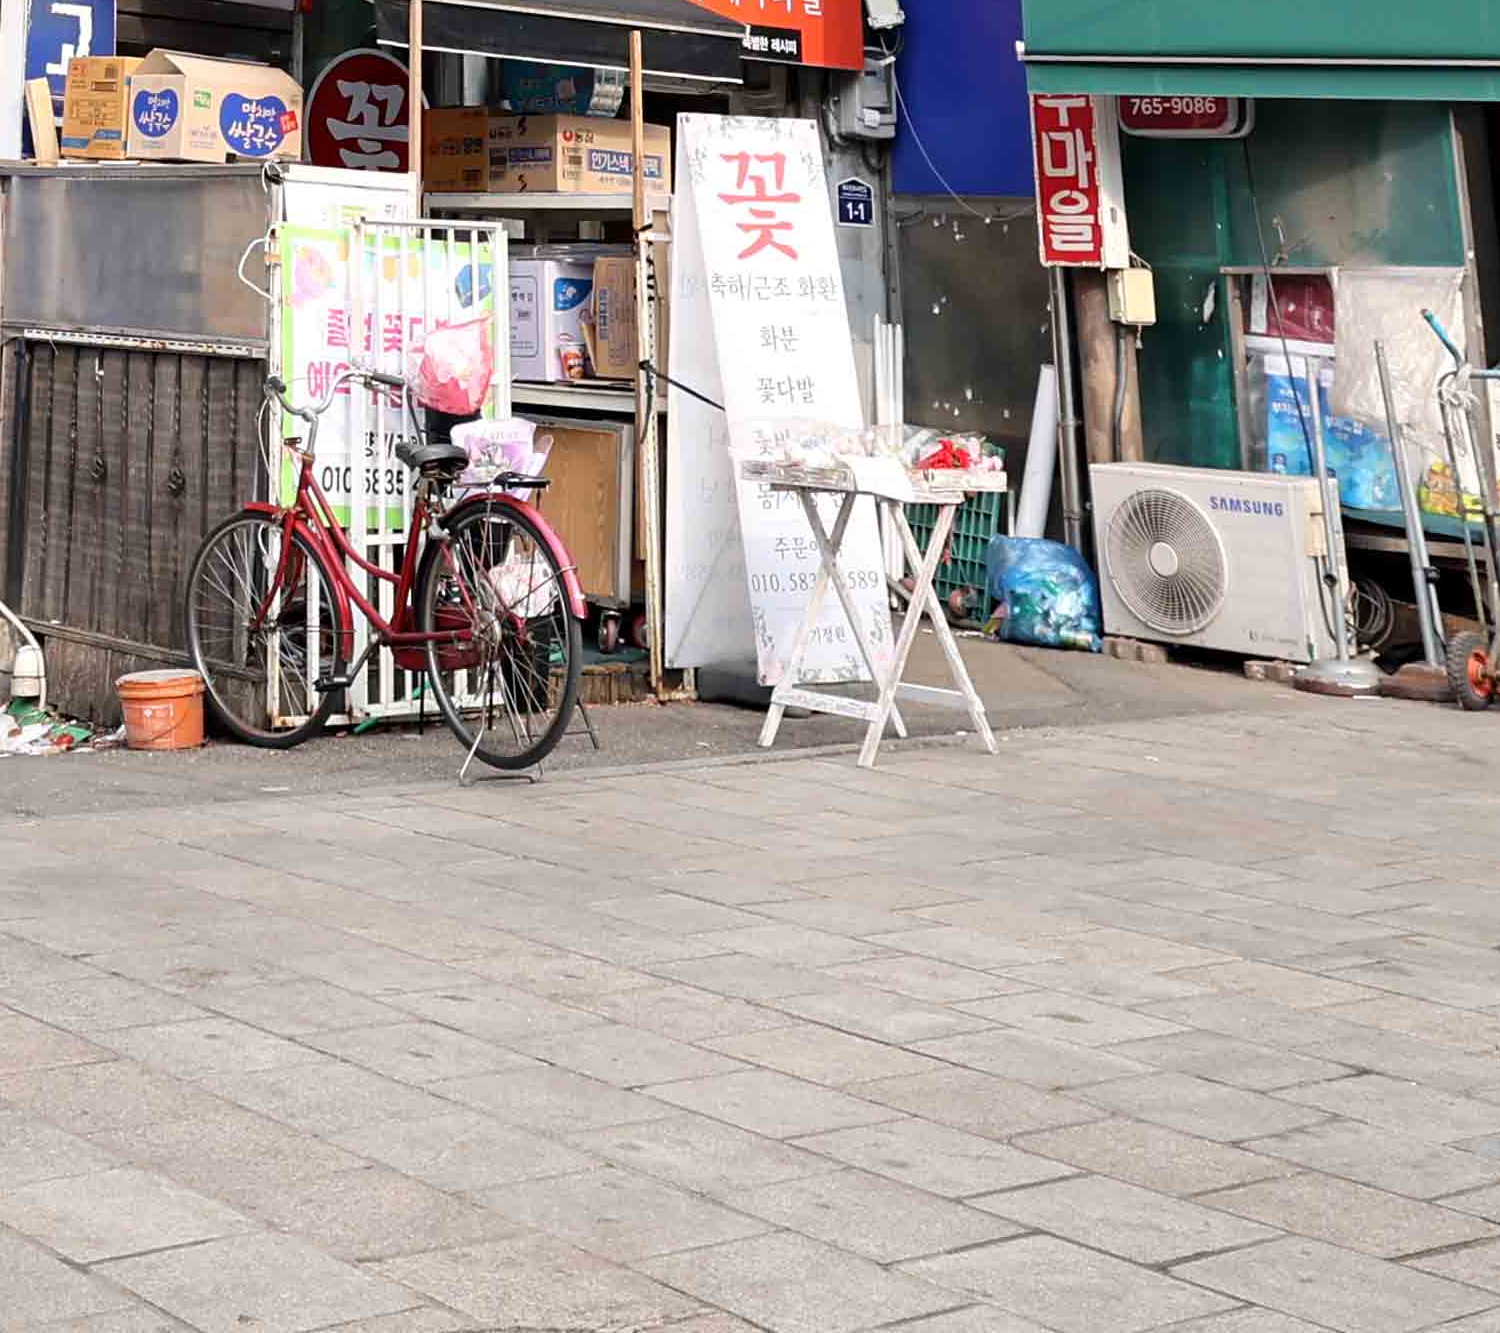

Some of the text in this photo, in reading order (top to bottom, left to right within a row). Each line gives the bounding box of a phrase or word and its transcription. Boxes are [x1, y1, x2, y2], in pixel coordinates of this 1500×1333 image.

[1129, 96, 1218, 117] 765-9086
[228, 119, 279, 150] 쌀국수
[716, 150, 802, 261] 꽃
[845, 201, 866, 221] 1-1
[711, 272, 839, 302] 축하/근조 화환
[759, 324, 800, 353] 화분
[757, 376, 815, 404] 꽃다발
[1207, 495, 1286, 519] SAMSUNG
[751, 571, 881, 593] 010.583.589
